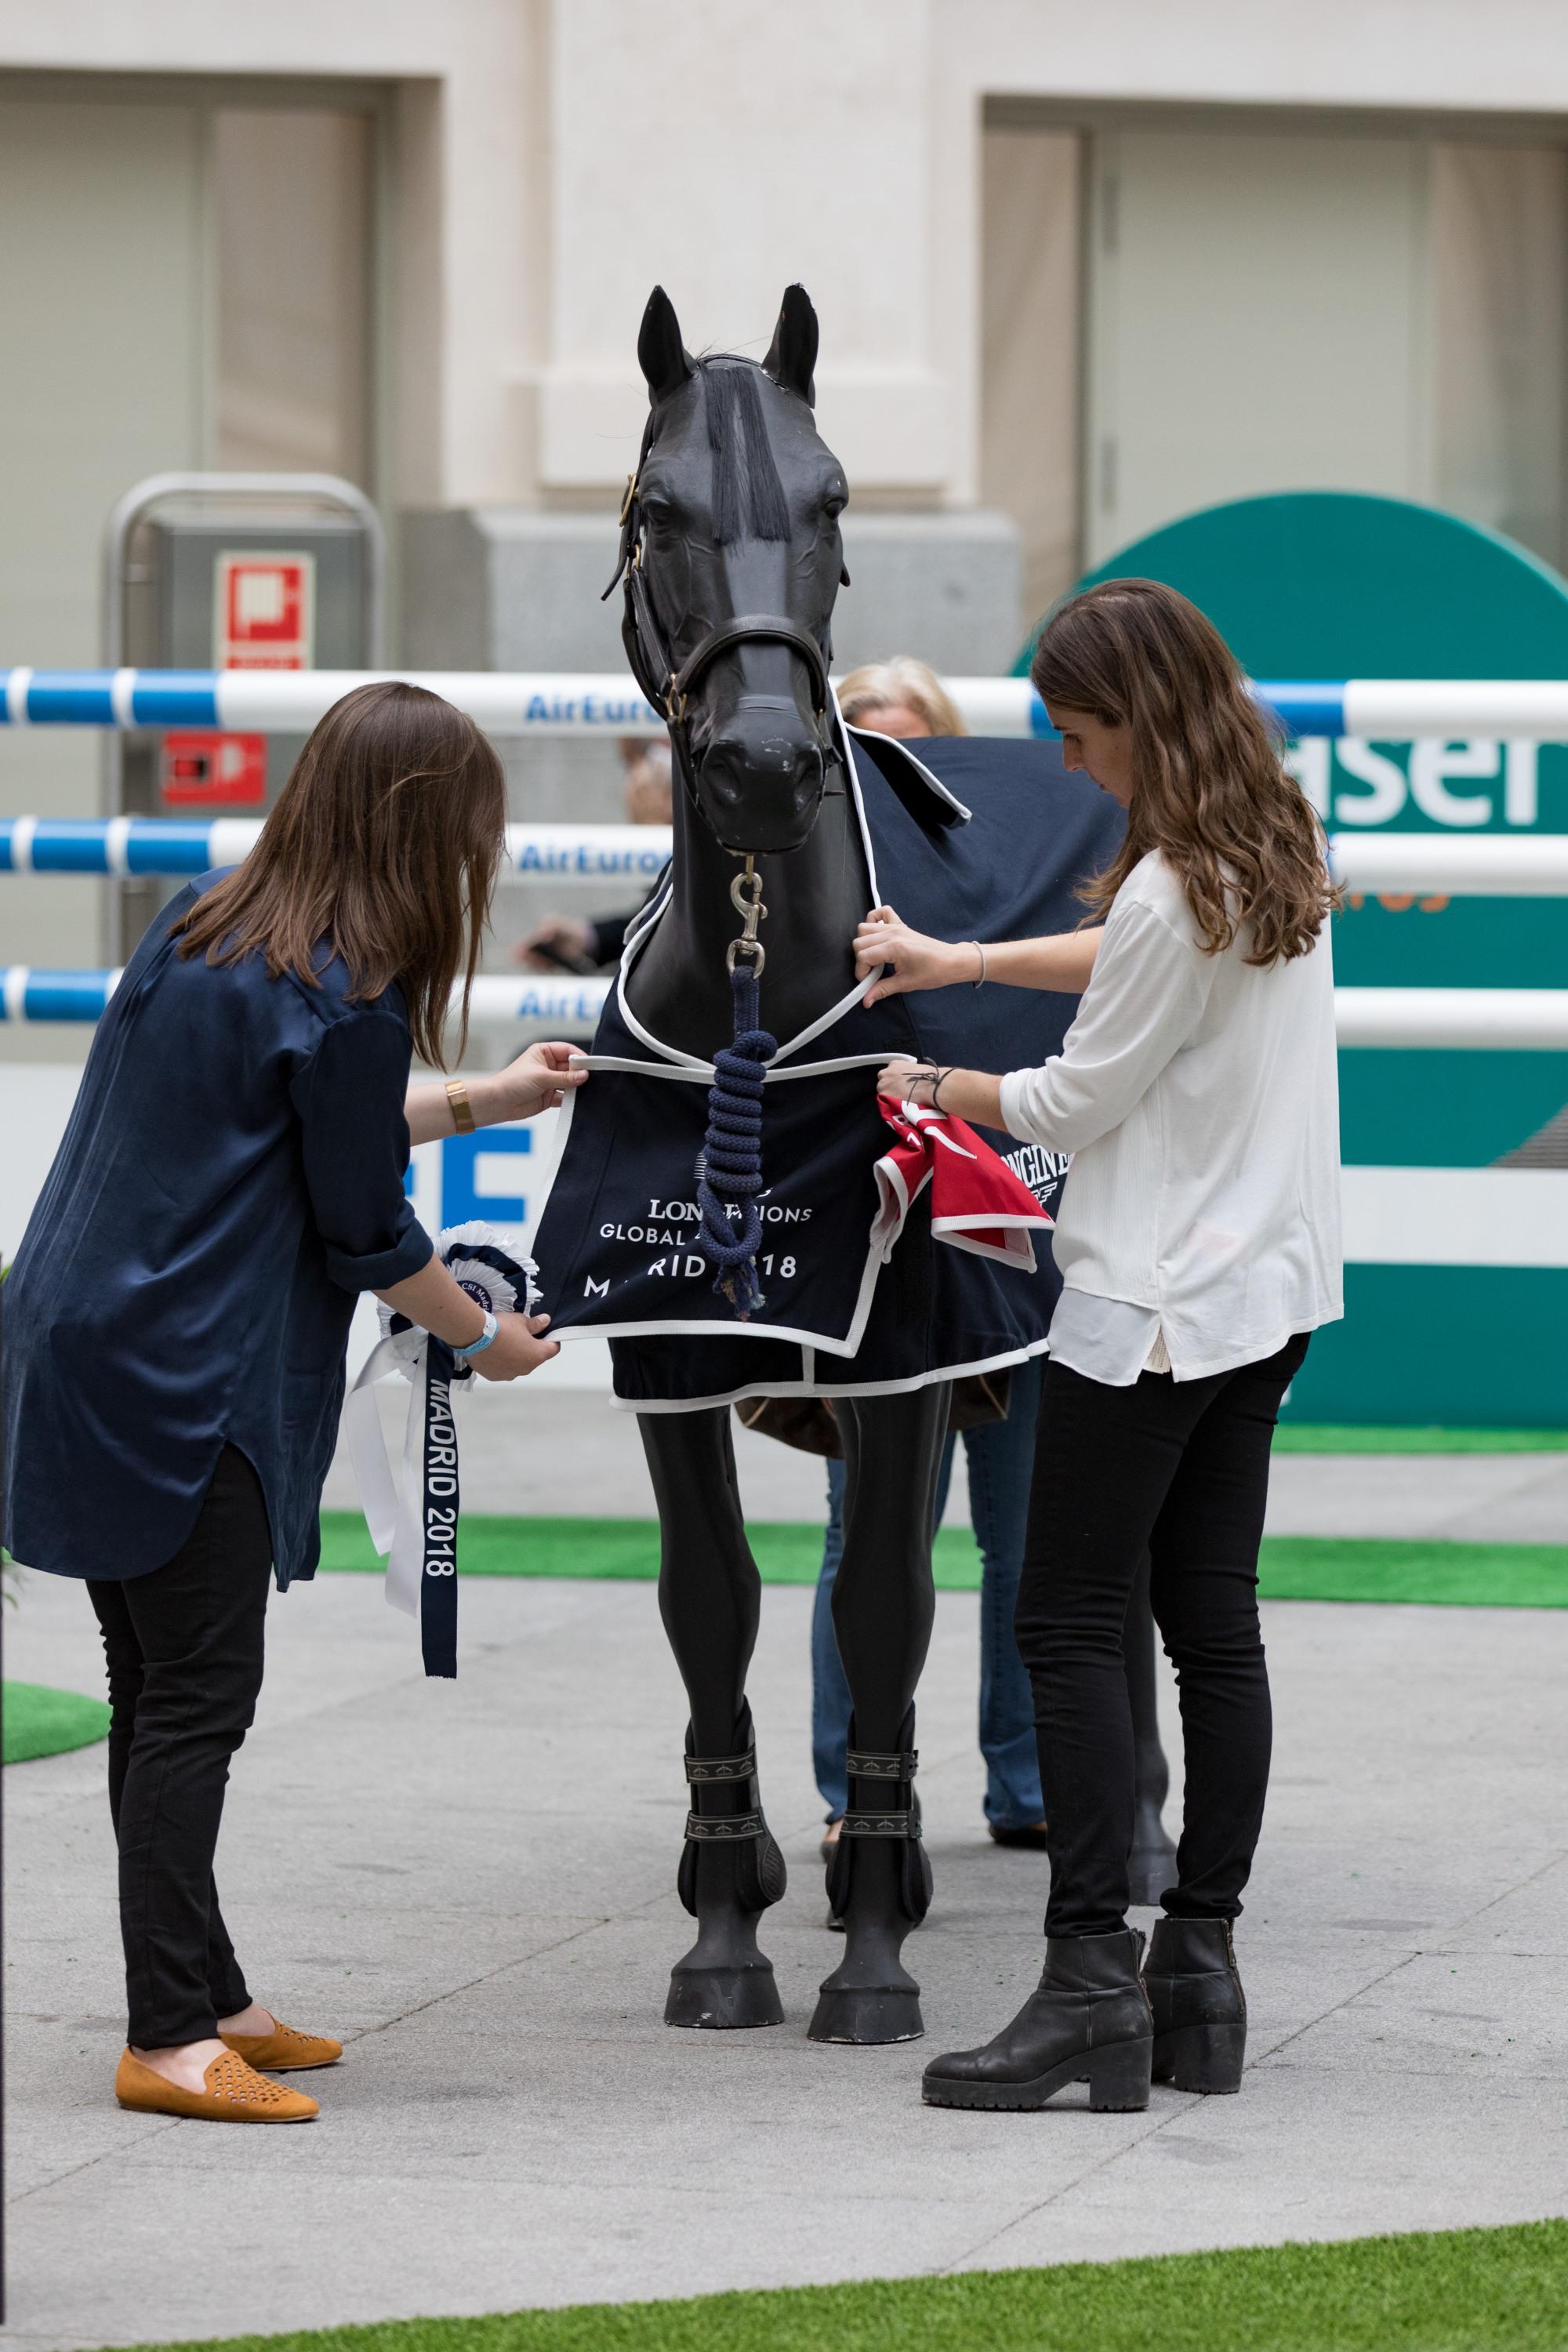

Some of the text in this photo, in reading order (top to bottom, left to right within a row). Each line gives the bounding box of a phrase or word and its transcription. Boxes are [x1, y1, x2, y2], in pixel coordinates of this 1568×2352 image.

[518, 843, 672, 876] AirEuro
[518, 989, 603, 1021] AirE
[600, 1223, 686, 1247] GLOBAL
[753, 1204, 812, 1222] IONS
[583, 1254, 797, 1298] MRID 18
[461, 1283, 490, 1311] CSI Madri
[426, 1378, 457, 1577] MADRID 2018
